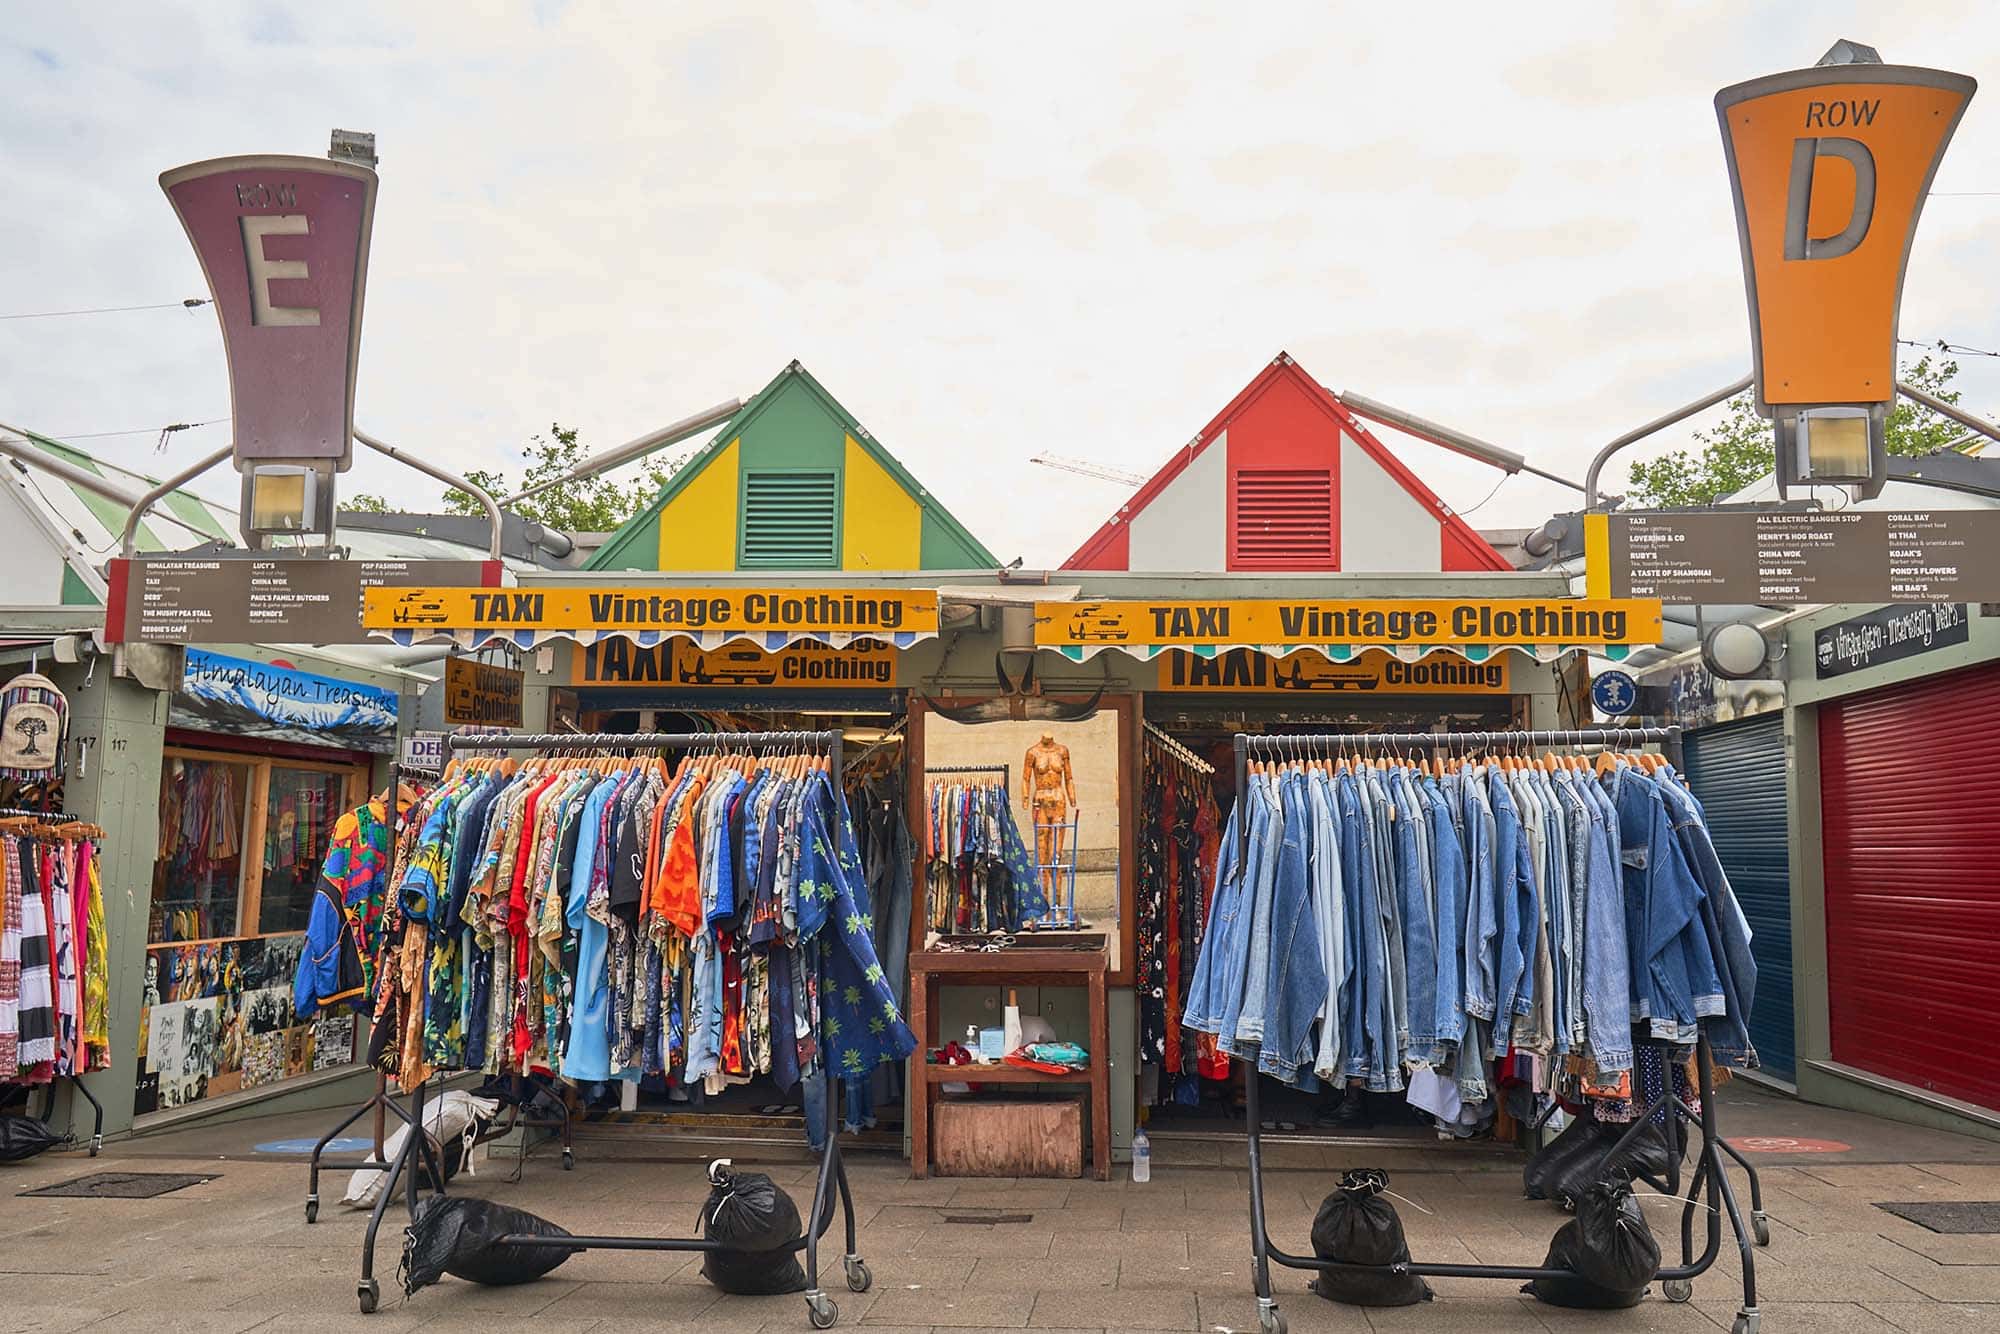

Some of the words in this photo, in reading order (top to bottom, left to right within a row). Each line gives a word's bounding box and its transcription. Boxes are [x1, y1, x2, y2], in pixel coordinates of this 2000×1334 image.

[1805, 99, 1881, 129] ROW
[235, 183, 298, 208] ROW
[1783, 137, 1877, 261] D
[237, 215, 321, 326] E
[1637, 569, 1661, 577] TASTE
[1661, 569, 1672, 577] OF
[1672, 569, 1712, 577] SHANGHAI
[1890, 567, 1919, 575] POND'S
[1919, 567, 1957, 575] FLOWERS
[1891, 584, 1904, 592] MR
[1904, 584, 1928, 592] BAG'S
[143, 609, 155, 617] THE
[156, 609, 178, 617] MUSHY
[178, 609, 191, 617] PEA
[192, 609, 212, 617] STALL
[470, 594, 544, 622] TAXI
[589, 594, 731, 626] Vintage
[743, 594, 903, 628] Clothing
[1149, 607, 1230, 637] TAXI
[1279, 606, 1437, 640] Vintage
[1451, 605, 1627, 640] Clothing
[476, 667, 520, 698] Vintage
[782, 656, 891, 682] Clothing
[1385, 661, 1502, 688] Clothing
[185, 655, 308, 705] Himalayan
[313, 680, 392, 712] Treasures
[474, 694, 521, 725] Clothing
[111, 739, 128, 751] 117
